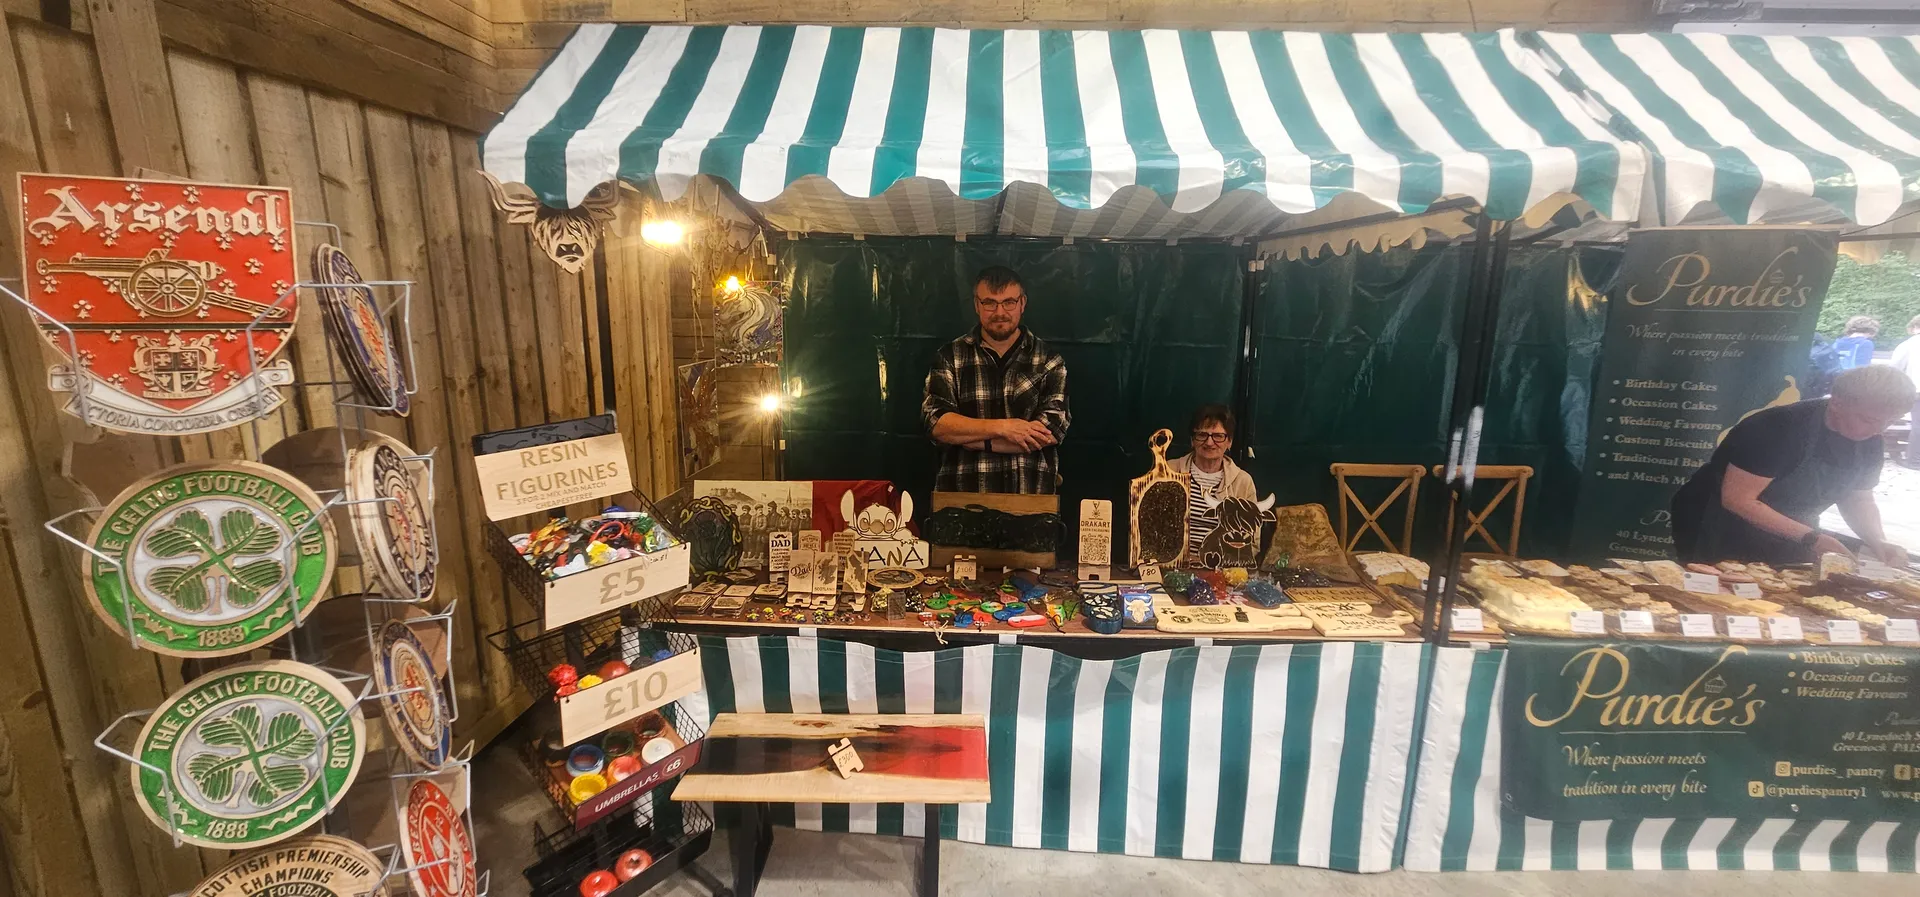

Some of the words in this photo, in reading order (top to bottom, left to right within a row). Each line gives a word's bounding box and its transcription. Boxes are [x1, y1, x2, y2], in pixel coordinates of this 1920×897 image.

[28, 186, 287, 236] Arsenal
[1626, 246, 1812, 308] Purdie's
[1627, 322, 1665, 339] Where
[1667, 331, 1712, 343] passion
[1715, 331, 1747, 341] meets
[1751, 324, 1799, 342] tradition
[1672, 347, 1685, 356] in
[1688, 349, 1719, 361] every
[1722, 341, 1744, 357] bite
[1624, 378, 1678, 391] Birthday
[1681, 380, 1718, 392] Cakes
[1621, 397, 1678, 409] Occasion
[1681, 400, 1718, 411] Cakes
[1619, 416, 1671, 429] Wedding
[1674, 418, 1723, 431] Favours
[1614, 434, 1660, 446] Custom
[1664, 437, 1714, 449] Biscuits
[520, 441, 588, 469] RESIN
[1612, 452, 1678, 467] Traditional
[496, 461, 618, 501] FIGURINES
[1607, 471, 1629, 480] and
[1632, 472, 1669, 484] Much
[183, 474, 289, 517] FOOTBALL
[523, 495, 540, 505] FOR
[546, 490, 561, 499] MIX
[563, 487, 580, 496] AND
[580, 481, 607, 492] MATCH
[535, 496, 575, 510] CHEAPEST
[574, 492, 593, 501] FREE
[111, 483, 180, 535] CELTIC
[289, 511, 322, 556] CLUB
[771, 539, 791, 548] DAD
[1616, 529, 1630, 539] 40
[98, 538, 127, 576] THE
[1608, 542, 1669, 558] Greenock
[791, 563, 812, 577] Dad
[600, 564, 647, 605] £5
[197, 627, 246, 648] 1888
[1801, 651, 1861, 667] Birthday
[1863, 653, 1907, 667] Cakes
[1525, 643, 1766, 728] Purdie's
[1802, 670, 1864, 684] Occasion
[1868, 671, 1909, 684] Cakes
[603, 671, 668, 721] £10
[1796, 687, 1853, 701] Wedding
[1857, 688, 1909, 700] Favours
[149, 715, 185, 753] THE
[177, 676, 248, 720] CELTIC
[253, 674, 340, 726] FOOTBALL
[331, 725, 352, 770] CLUB
[1833, 742, 1887, 752] Greenock
[1841, 731, 1855, 741] 40
[1857, 731, 1913, 743] Lynedoch
[1562, 741, 1610, 767] Where
[1612, 752, 1664, 772] passion
[1668, 752, 1707, 765] meets
[1846, 767, 1886, 779] pantry
[594, 771, 659, 813] UMBRELLAS
[665, 758, 682, 773] £6
[1563, 770, 1617, 797] tradition
[1621, 781, 1637, 794] in
[1640, 783, 1676, 801] every
[1681, 769, 1707, 794] bite
[1766, 784, 1867, 800] @purdiespantry1
[204, 819, 250, 840] 1888
[196, 855, 270, 897] COTTISH
[276, 848, 370, 878] PREMIERSHIP
[240, 866, 334, 896] CHAMPIONS
